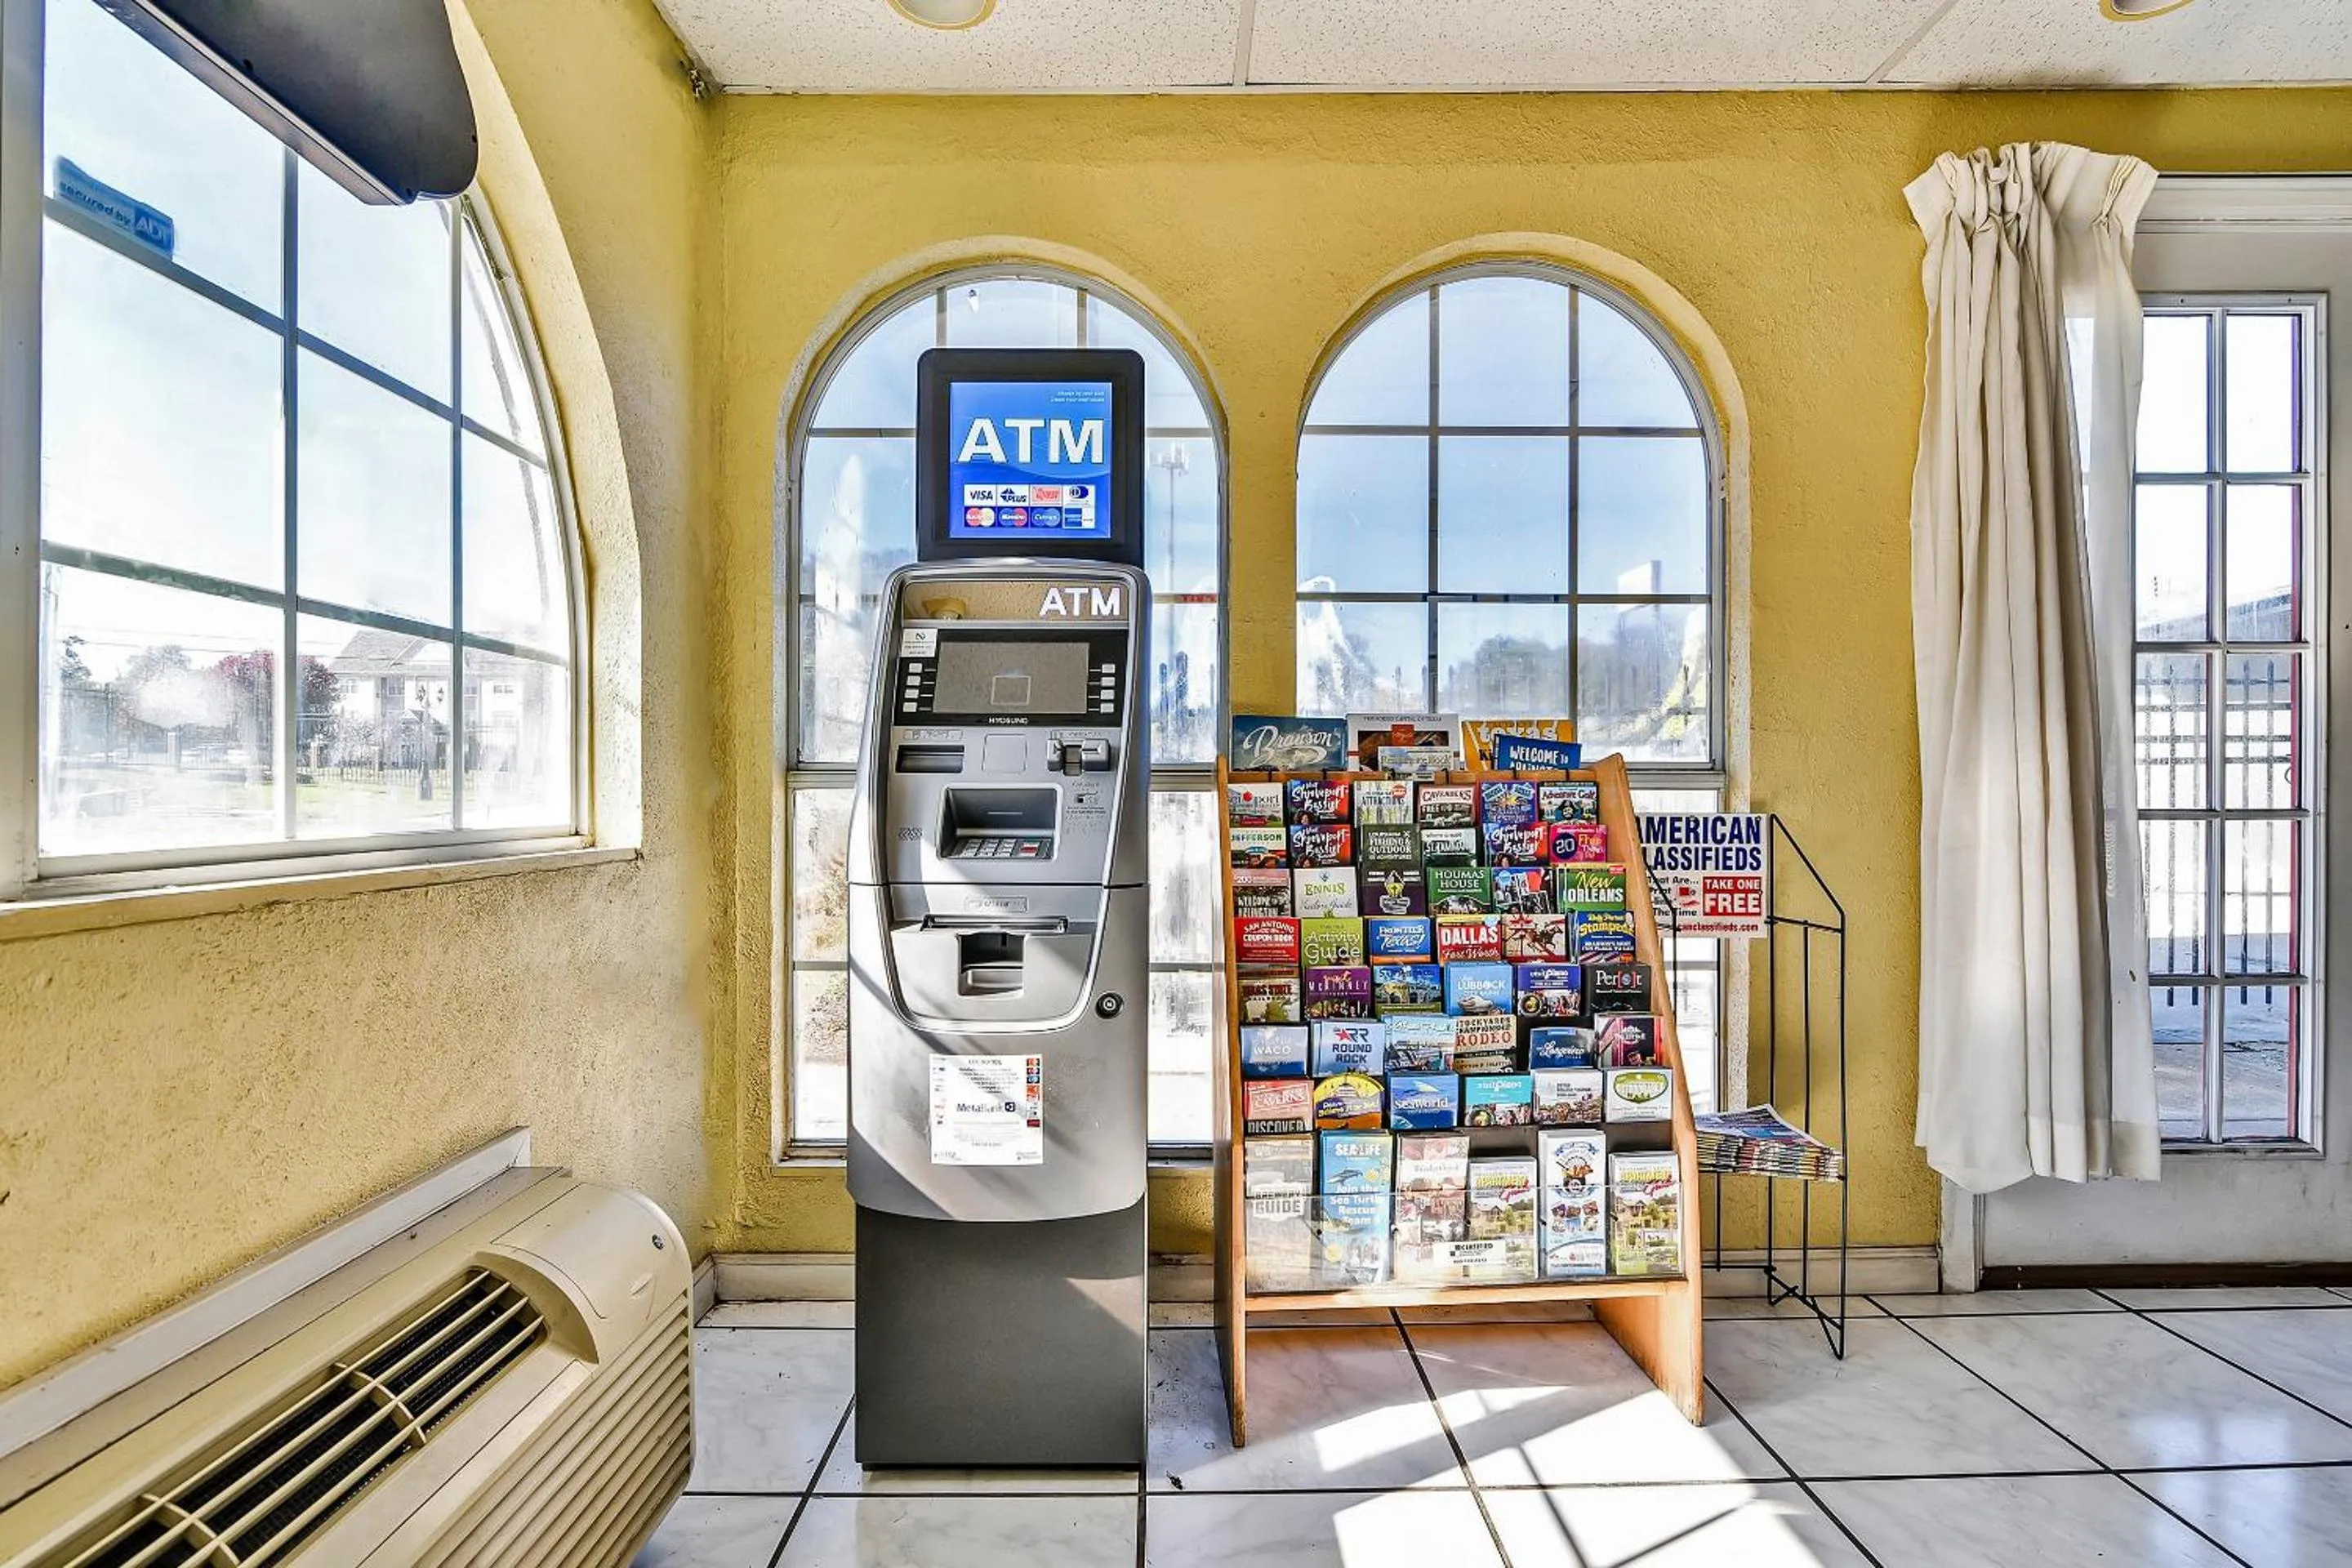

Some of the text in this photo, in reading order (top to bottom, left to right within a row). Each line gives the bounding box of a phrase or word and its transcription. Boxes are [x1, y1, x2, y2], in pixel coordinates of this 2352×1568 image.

[60, 181, 114, 216] secured
[115, 211, 131, 227] by
[957, 417, 1104, 464] ATM
[970, 490, 993, 500] VISA
[1040, 587, 1120, 617] ATM
[1243, 725, 1333, 767] Branson
[1509, 746, 1558, 764] WELCOME
[1637, 816, 1761, 844] MERICAN
[1232, 833, 1282, 841] JEFFERSON
[1556, 839, 1575, 853] 20
[1642, 847, 1762, 871] LASSIFIEDS
[1435, 870, 1485, 879] HOUMAS
[1576, 871, 1615, 889] New
[1304, 883, 1346, 896] ENNIS
[1441, 880, 1480, 889] HOUSE
[1705, 880, 1760, 889] TAKE ONE
[1568, 889, 1624, 902] ORLEANS
[1704, 893, 1760, 913] FREE
[1244, 923, 1259, 933] SAN
[1243, 933, 1274, 942] COUPON
[1305, 931, 1360, 946] Activity
[1441, 927, 1499, 945] DALLAS
[1304, 942, 1361, 963] Guide
[1457, 981, 1506, 991] LUBBOCK
[1456, 1031, 1512, 1046] RODEO
[1254, 1046, 1292, 1054] WACO
[1333, 1045, 1372, 1053] ROUND
[1336, 1054, 1367, 1063] ROCK
[1335, 1144, 1357, 1156] SEA
[1336, 1185, 1358, 1193] Join
[1255, 1200, 1302, 1214] GUIDE
[1330, 1196, 1350, 1205] Sea
